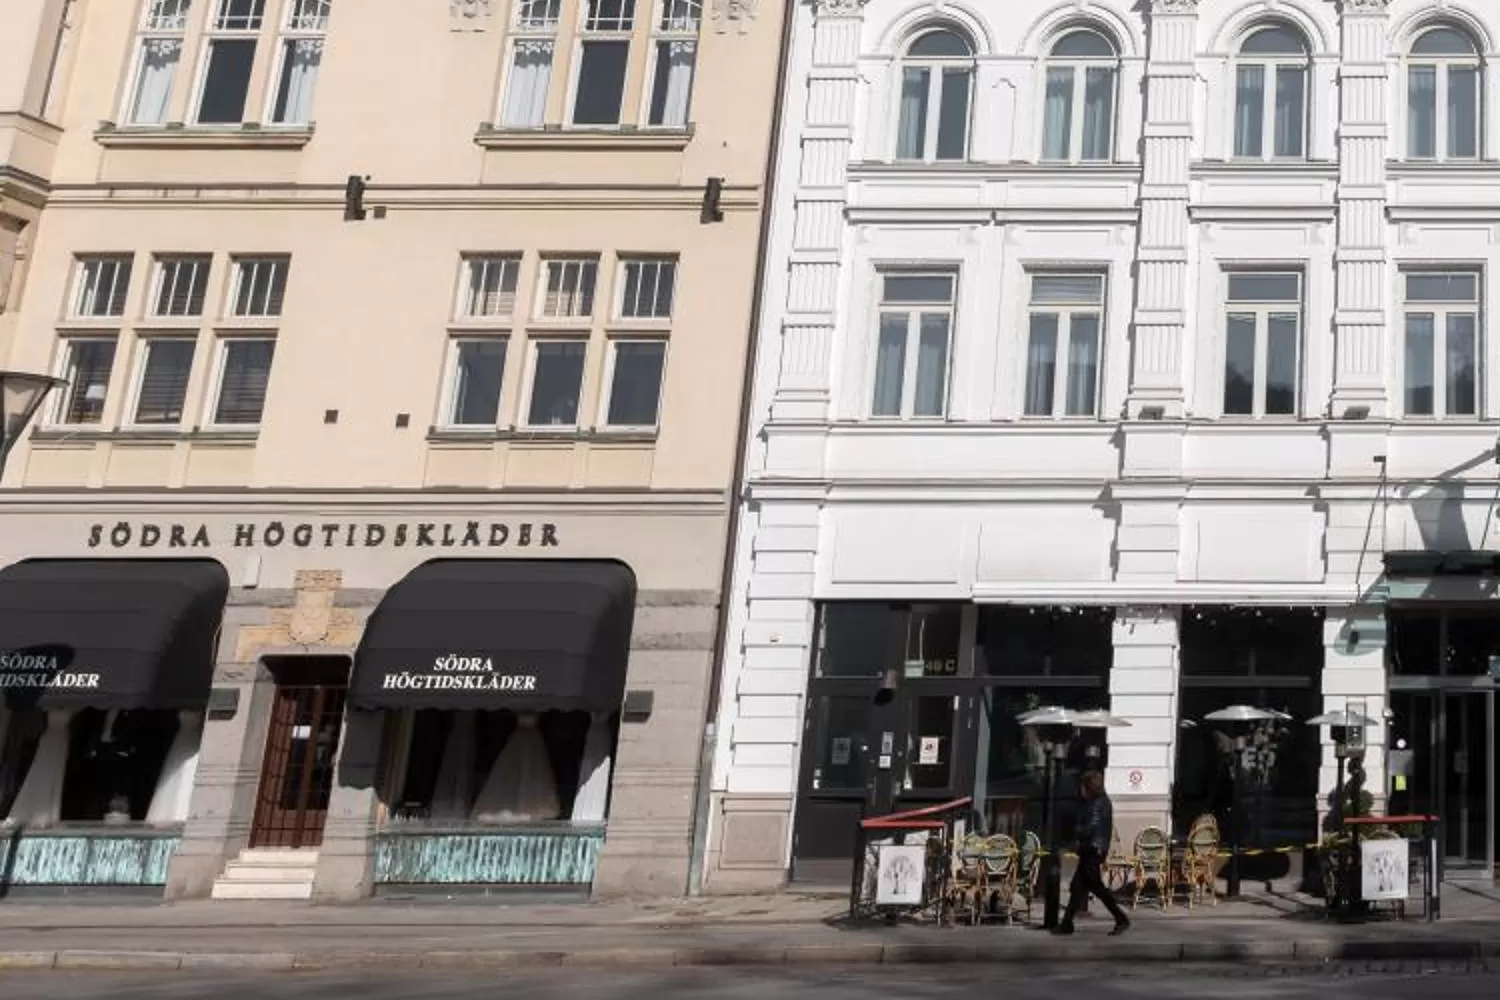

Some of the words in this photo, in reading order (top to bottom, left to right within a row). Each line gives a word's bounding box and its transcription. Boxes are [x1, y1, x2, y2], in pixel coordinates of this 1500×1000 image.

[87, 522, 212, 548] SÖDRA
[233, 521, 560, 548] HÖGTIDSKLÄDER
[433, 654, 493, 671] SÖDRA
[383, 671, 537, 690] HÖGTIDSKLÄDER
